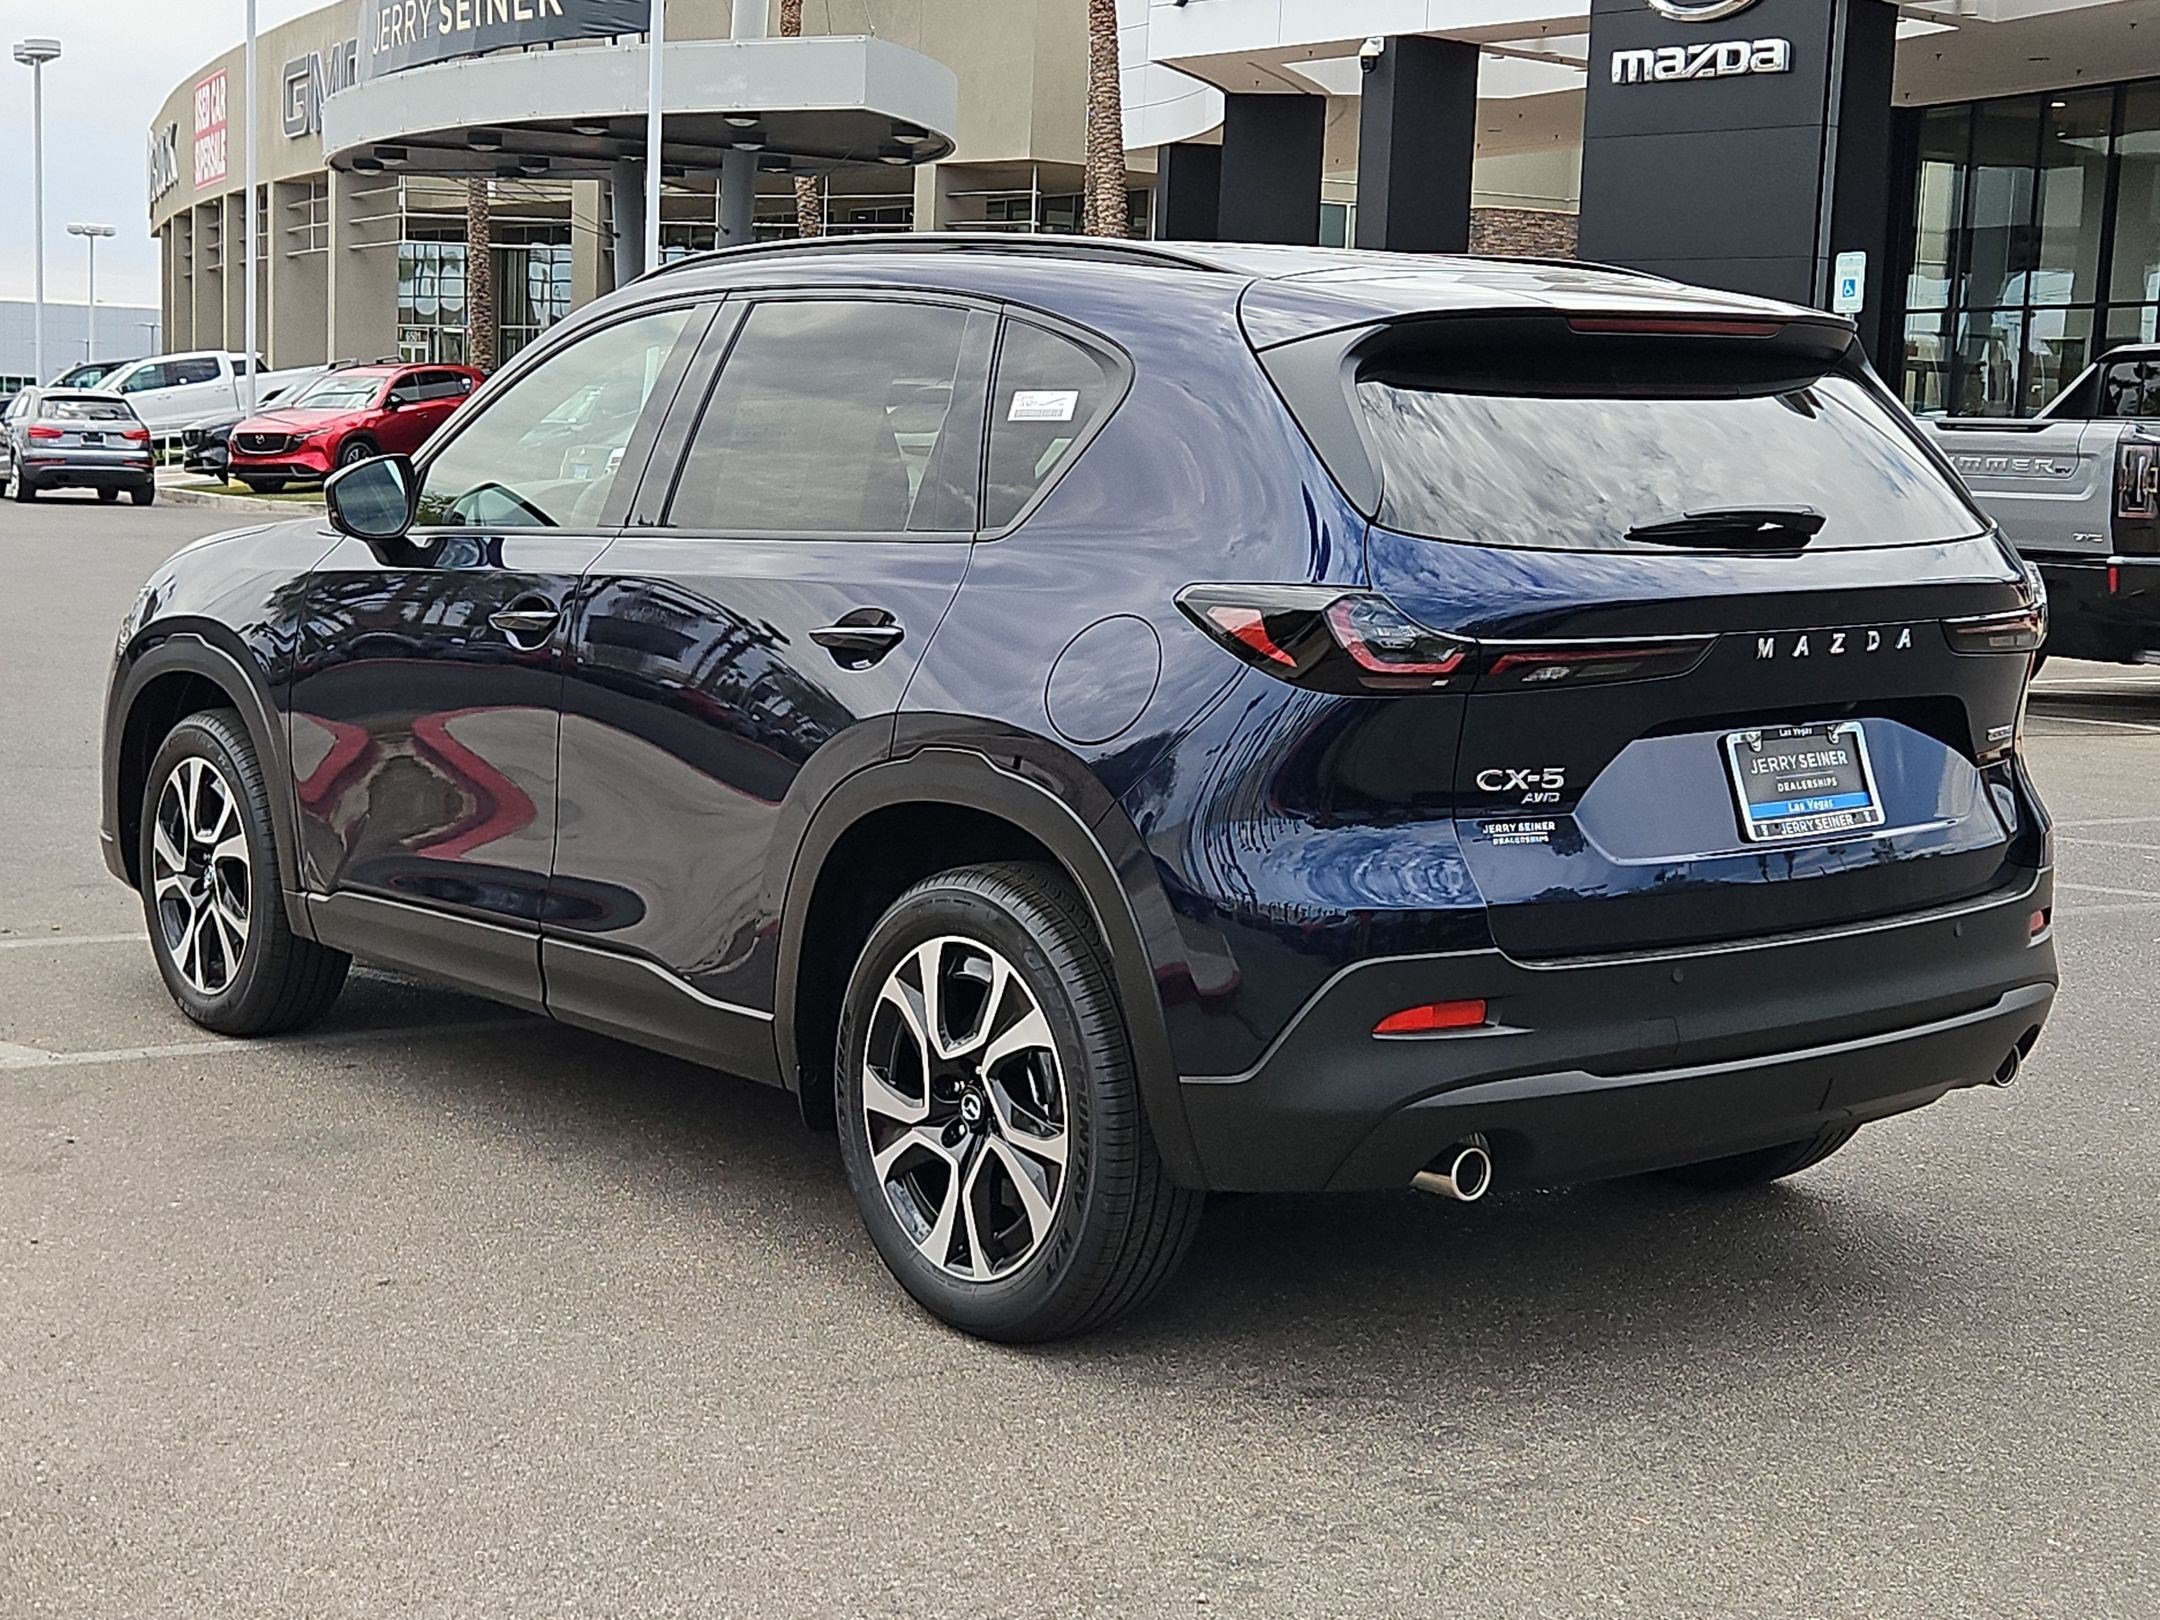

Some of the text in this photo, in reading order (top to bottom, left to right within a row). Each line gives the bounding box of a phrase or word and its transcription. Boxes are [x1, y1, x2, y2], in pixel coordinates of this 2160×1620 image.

[372, 0, 432, 55] JERRY
[1949, 456, 2054, 474] MMER
[1756, 628, 1912, 660] MAZDA
[1751, 750, 1849, 774] JERRY SEINER
[1476, 767, 1566, 791] CX-5
[1777, 777, 1838, 793] DEALERSHIPS
[1788, 799, 1834, 812] Las Vegas
[1483, 821, 1556, 834] JERRY SEINER
[1781, 814, 1855, 835] JERRY SEINER
